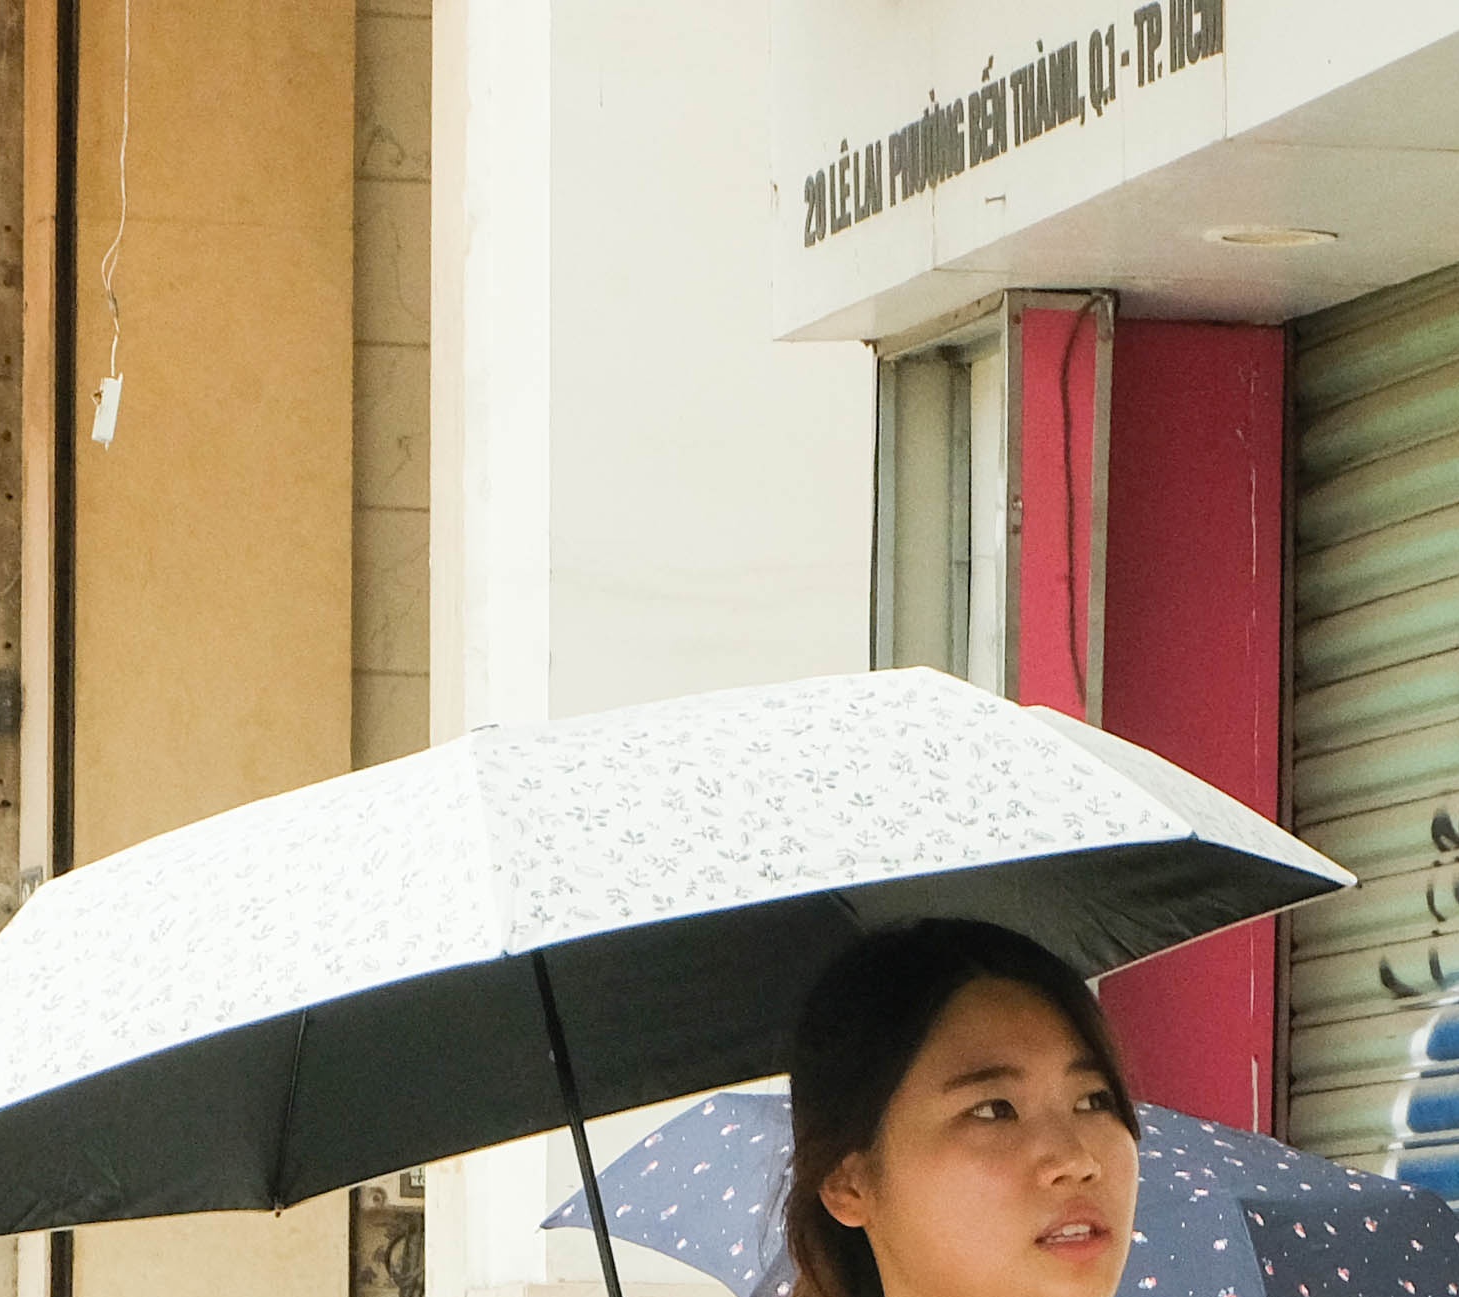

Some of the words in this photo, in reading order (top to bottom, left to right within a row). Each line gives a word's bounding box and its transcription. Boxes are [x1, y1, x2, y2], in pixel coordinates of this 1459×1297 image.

[829, 137, 852, 235] LÊ
[853, 139, 883, 224] LAI
[968, 54, 1007, 169] BẾN
